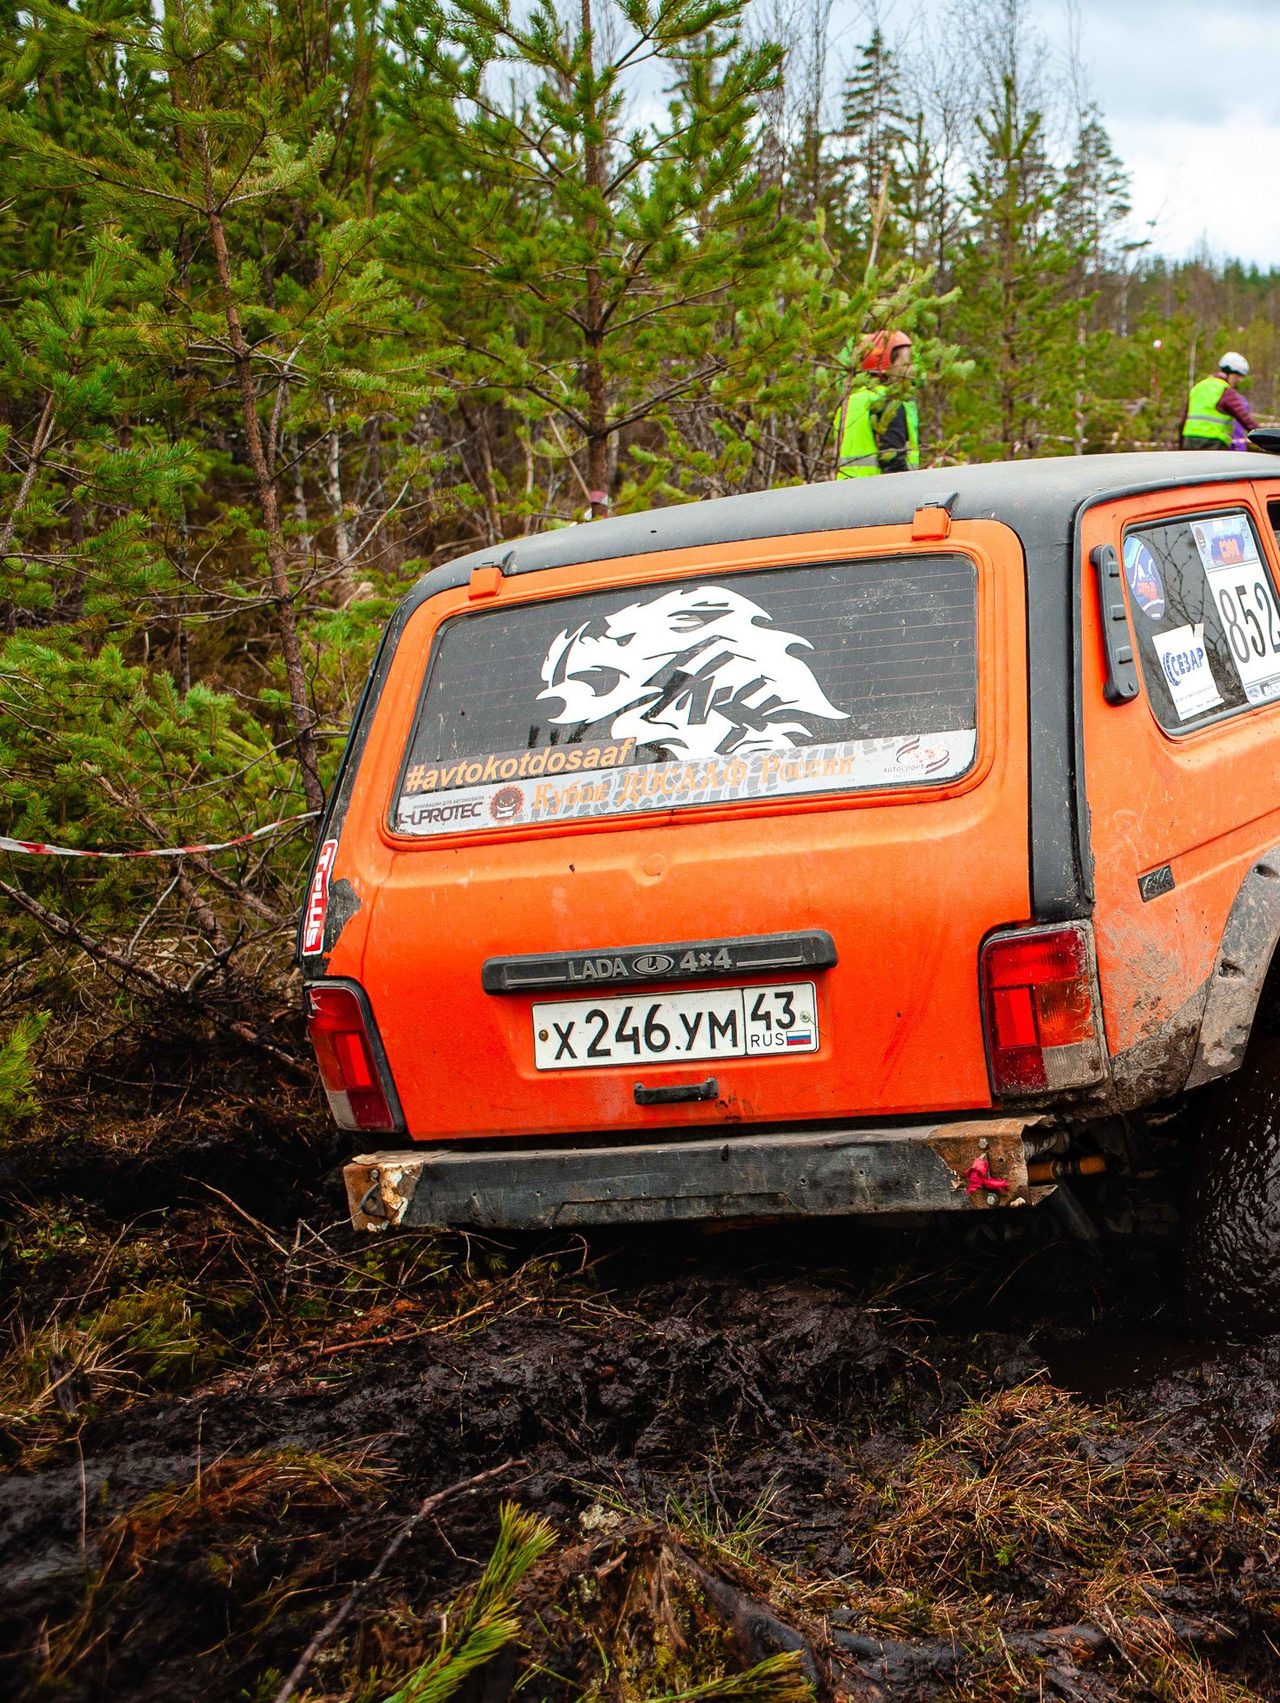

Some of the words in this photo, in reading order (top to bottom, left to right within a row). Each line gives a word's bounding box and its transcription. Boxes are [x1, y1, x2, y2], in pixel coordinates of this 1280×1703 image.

[1171, 647, 1204, 677] СЕЗАР
[405, 737, 637, 792] #avtokotdosaaf
[532, 779, 608, 814] Кубок
[616, 756, 748, 806] ДОСААФ
[760, 752, 855, 784] России
[398, 801, 483, 826] SUPROTEC
[567, 956, 630, 981] LADA
[750, 990, 797, 1031] 43
[750, 1034, 785, 1048] RUS
